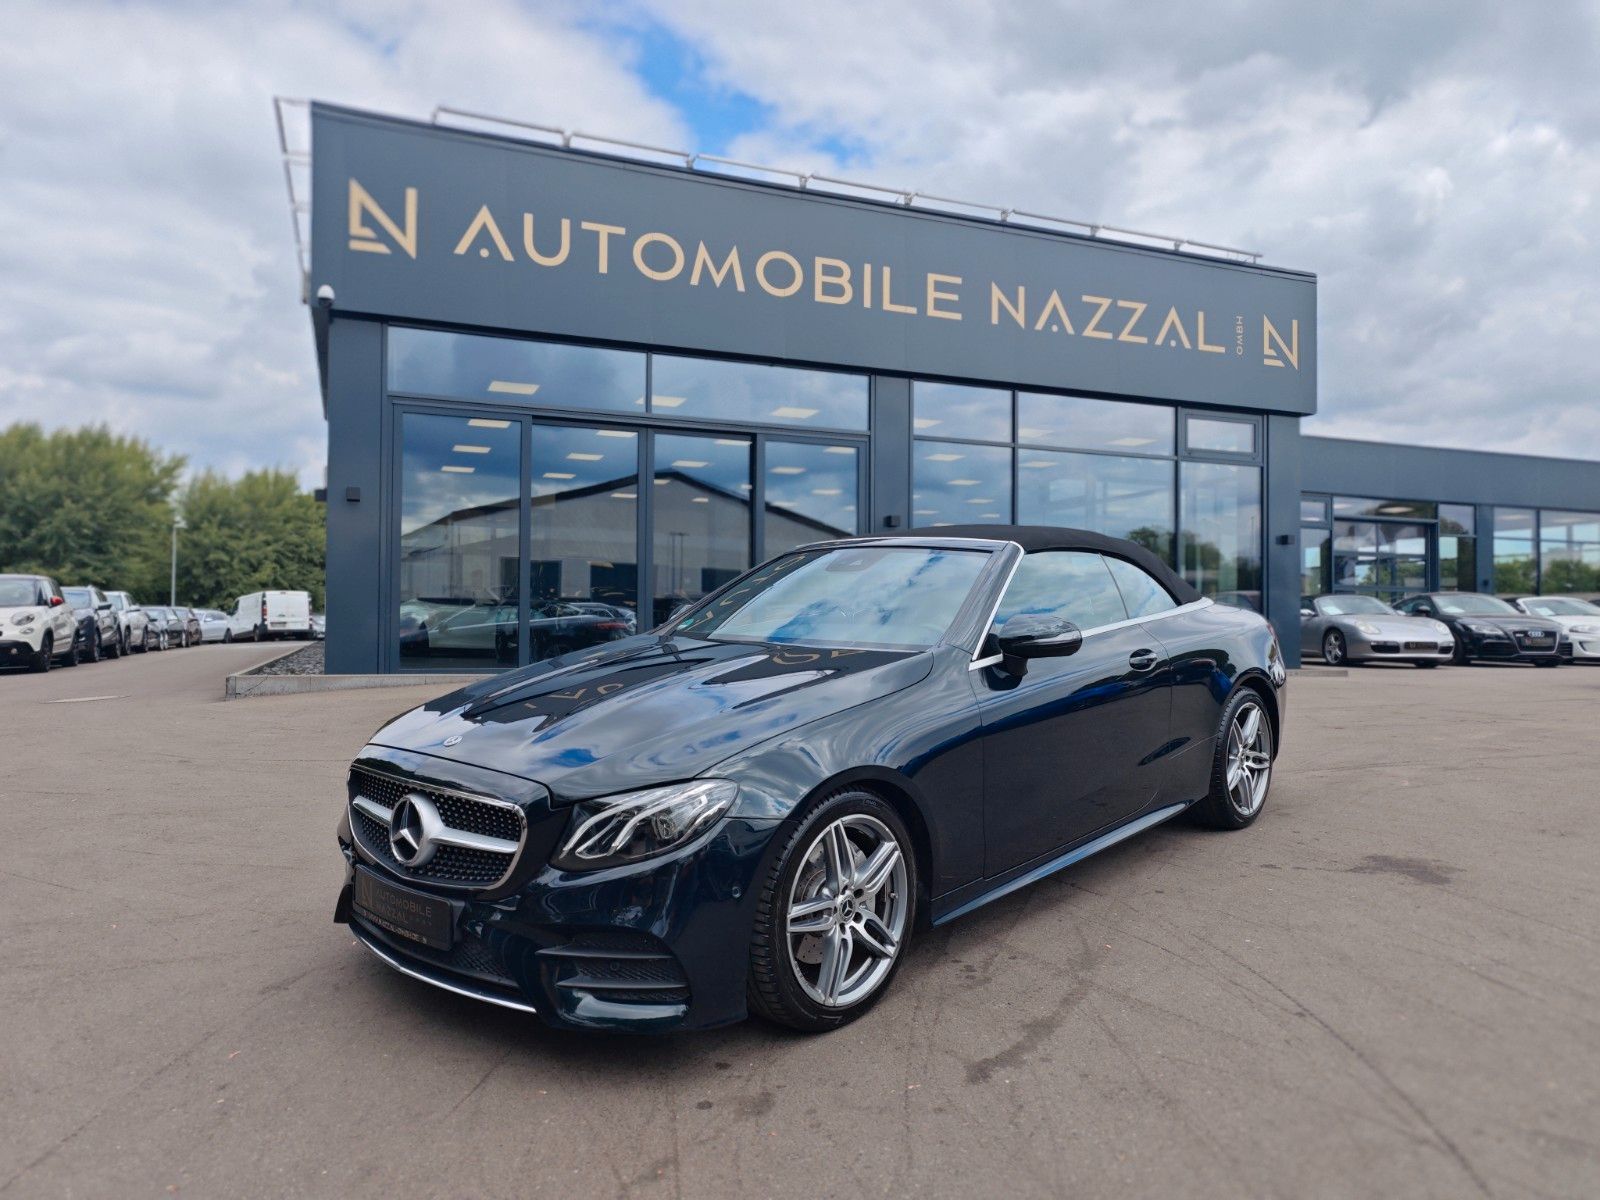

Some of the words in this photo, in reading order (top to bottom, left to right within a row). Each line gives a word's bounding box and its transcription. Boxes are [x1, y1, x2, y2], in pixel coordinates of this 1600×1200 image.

[454, 204, 963, 321] AUTOMOBILE
[991, 281, 1226, 354] NAZZAL
[376, 887, 432, 918] AUTOMOBILE
